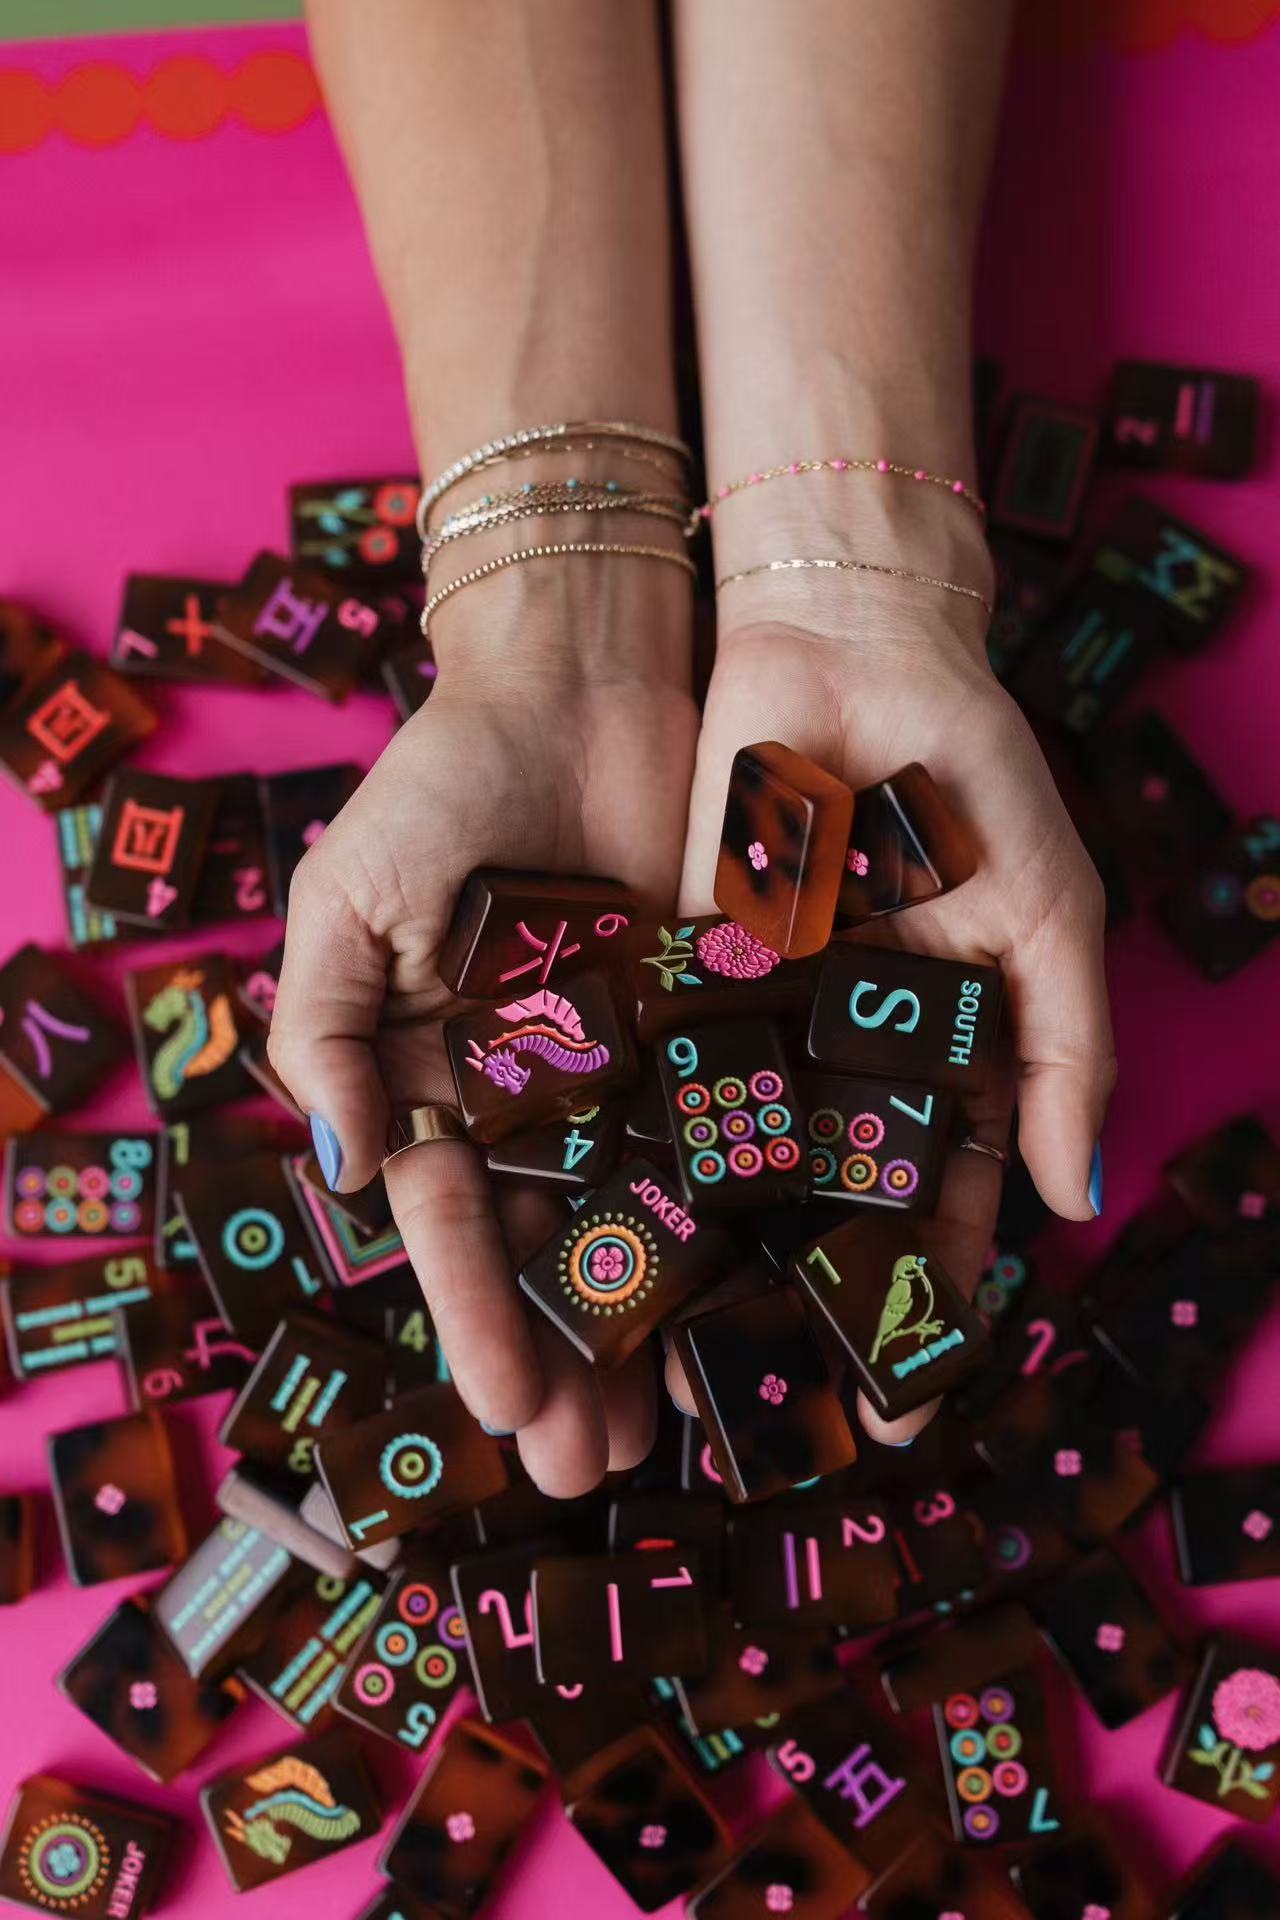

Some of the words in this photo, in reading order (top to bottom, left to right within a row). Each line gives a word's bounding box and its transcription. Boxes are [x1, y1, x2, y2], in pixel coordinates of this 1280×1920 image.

[337, 600, 379, 638] 5
[848, 980, 921, 1033] S
[948, 980, 982, 1065] SOUTH
[666, 1037, 698, 1077] 9
[889, 1094, 934, 1126] 7
[562, 1128, 594, 1171] 4
[628, 1176, 697, 1243] JOKER
[806, 1246, 842, 1286] 1
[399, 1309, 430, 1352] 4
[349, 1508, 390, 1541] 1
[842, 1514, 886, 1548] 2
[650, 1566, 694, 1588] 1
[397, 1702, 437, 1746] 5
[778, 1739, 816, 1782] 5
[1028, 1787, 1061, 1834] 7
[107, 1839, 147, 1919] JOKER
